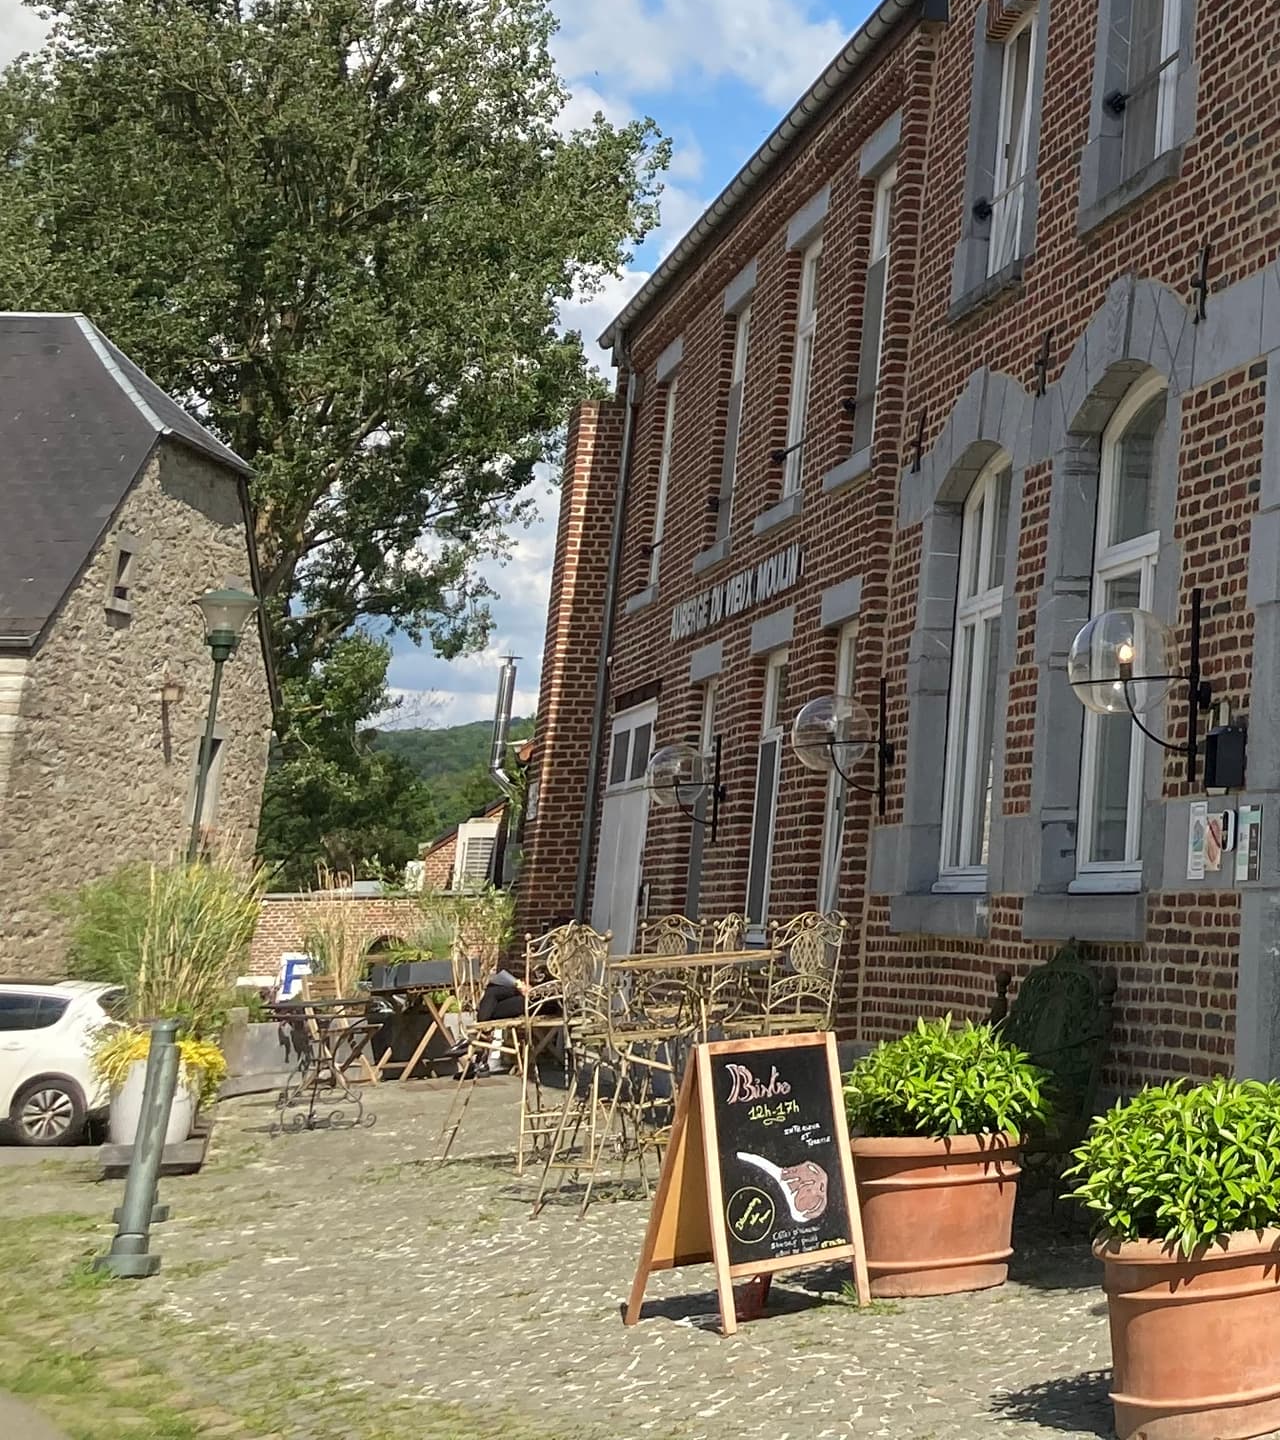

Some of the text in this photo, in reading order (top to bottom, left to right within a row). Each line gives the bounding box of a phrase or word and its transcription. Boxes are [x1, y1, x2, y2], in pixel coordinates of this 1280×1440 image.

[710, 582, 725, 625] DU
[725, 567, 755, 617] VIEUX
[755, 542, 799, 603] MOULIN
